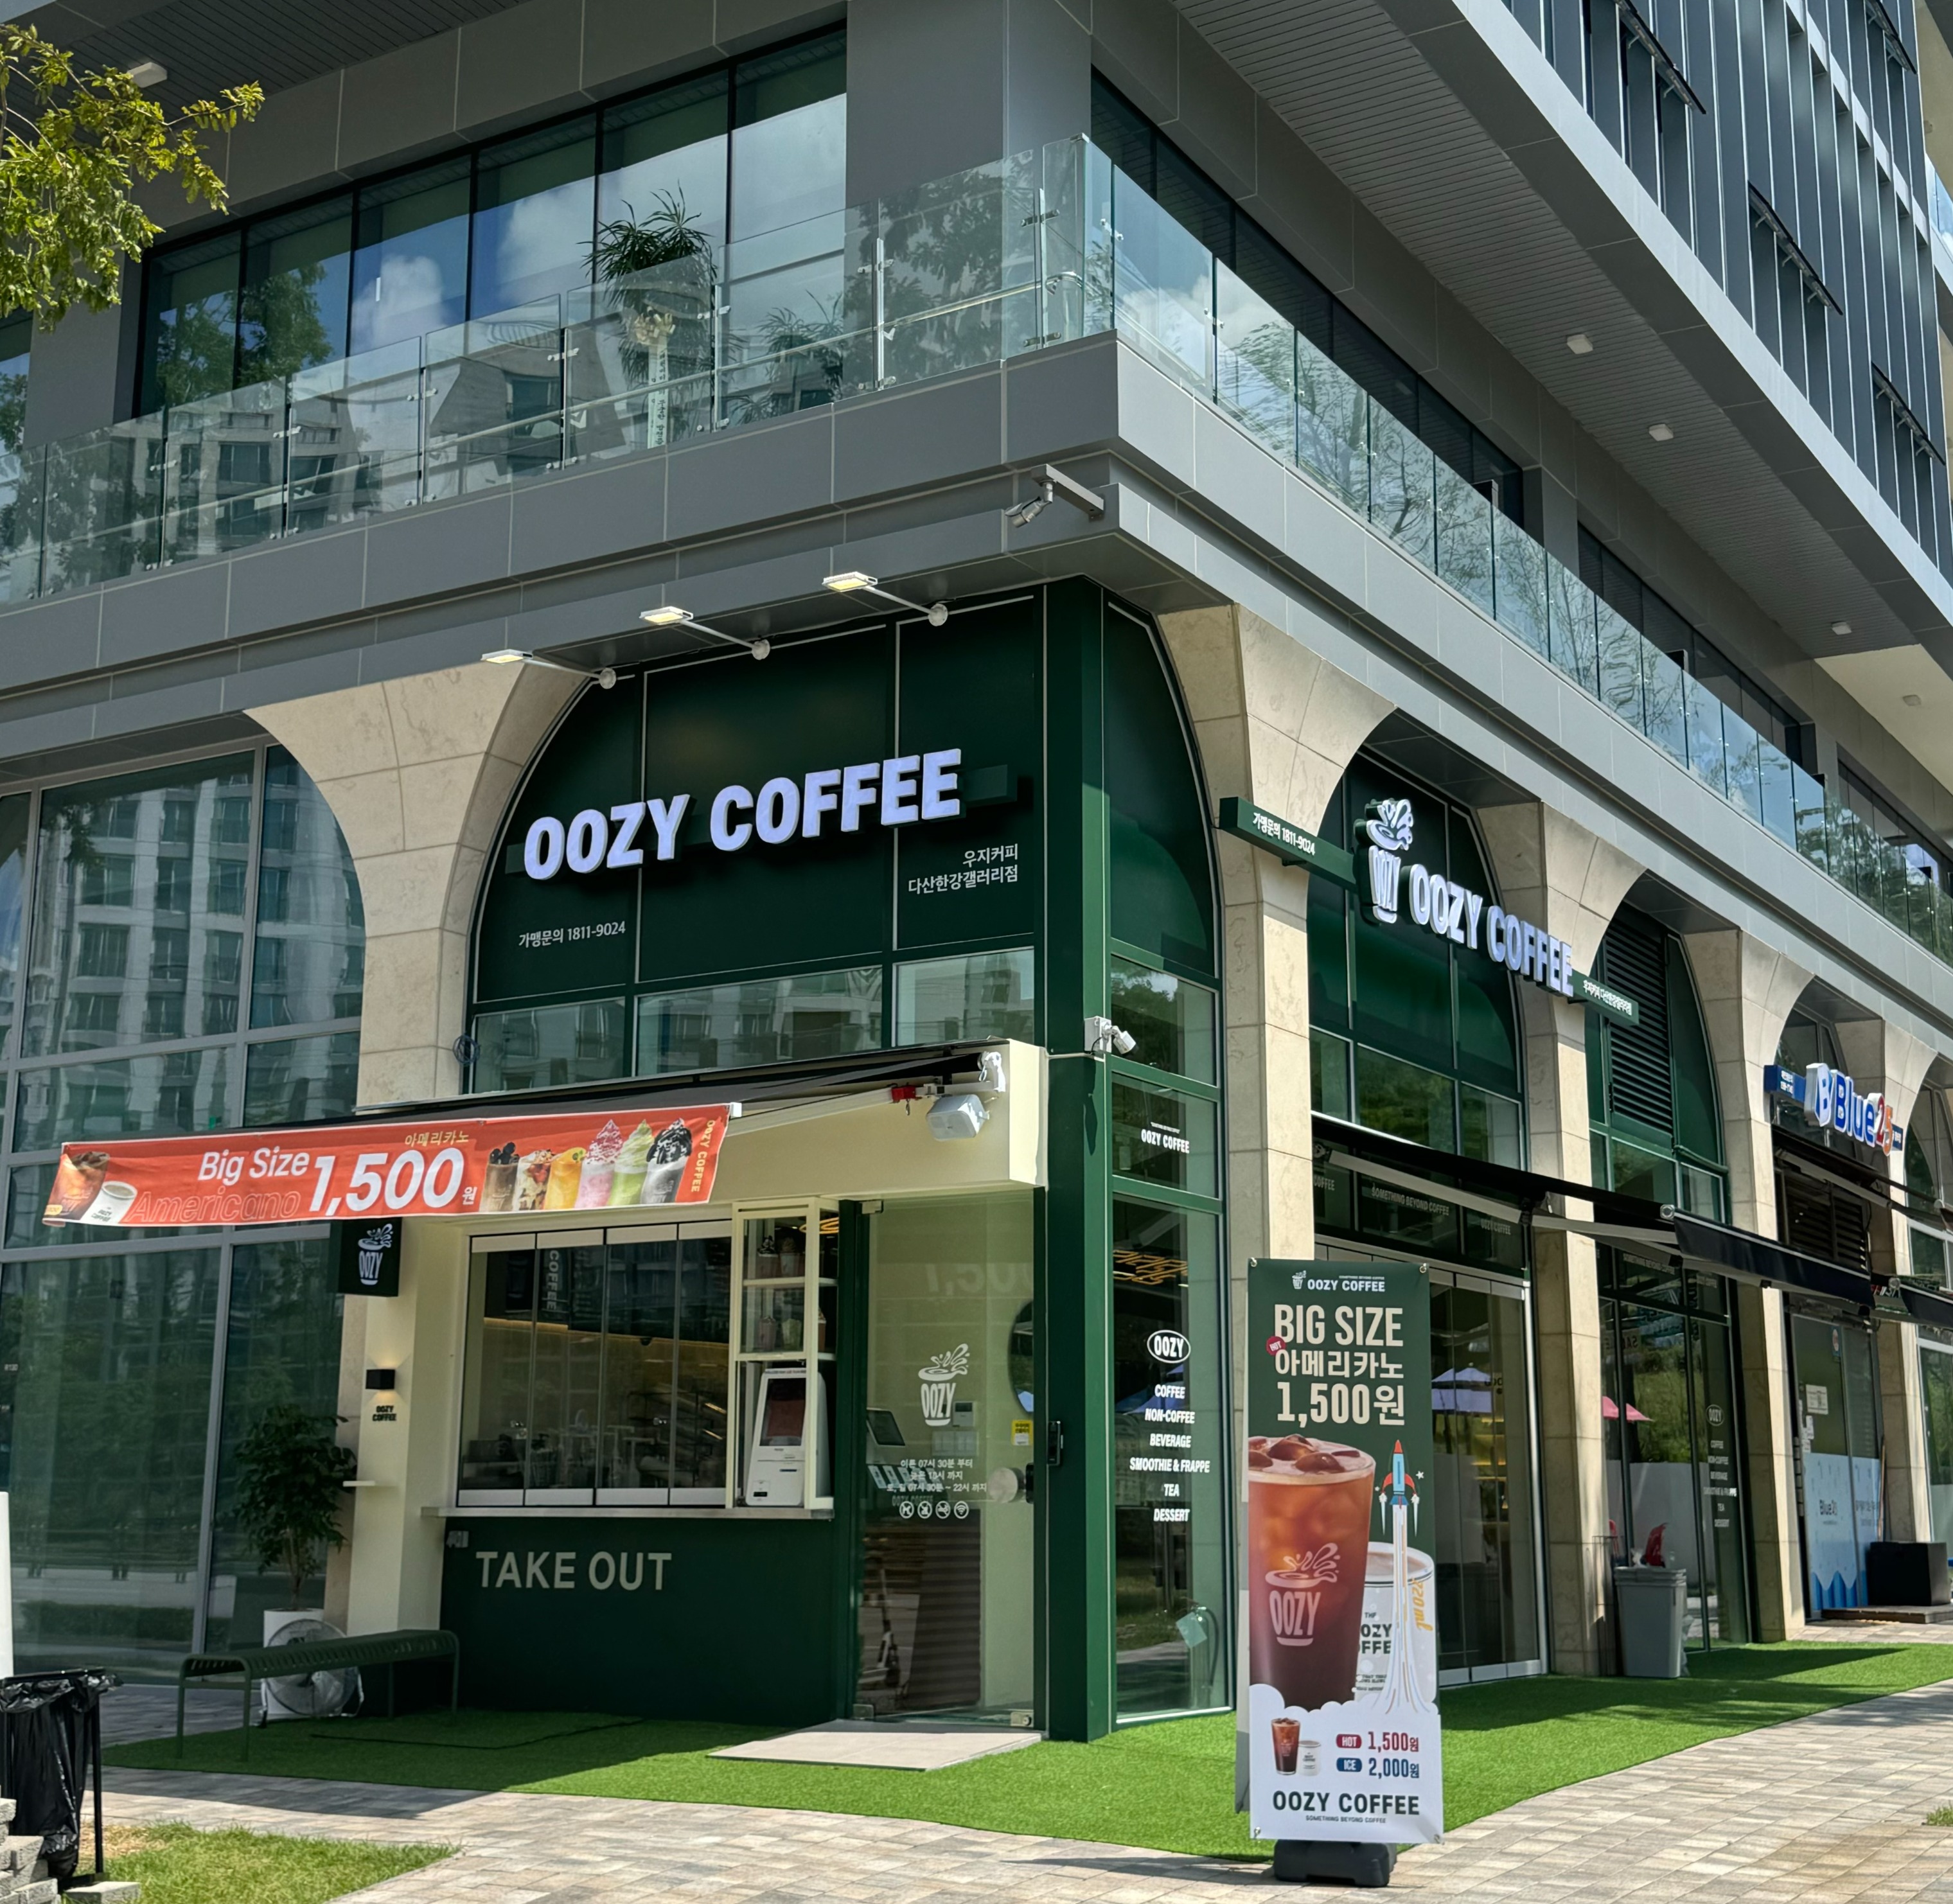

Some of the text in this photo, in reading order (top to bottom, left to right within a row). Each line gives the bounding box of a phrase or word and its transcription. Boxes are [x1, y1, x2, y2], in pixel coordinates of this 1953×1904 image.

[524, 748, 962, 881] OOZY COFFEE
[1253, 812, 1315, 856] 가맹문의 1811-9024
[962, 842, 1019, 868] 우지커피
[908, 865, 1019, 895] 다산한강갤러리점
[518, 921, 626, 949] 가맹문의 1811-9024
[1409, 863, 1574, 998] OOZY COFFEE
[404, 1130, 470, 1147] 아메리카노
[1141, 1129, 1190, 1154] OOZY COFFEE
[198, 1145, 309, 1186] Big Size
[691, 1120, 716, 1192] OOZY COFFEE
[126, 1186, 301, 1224] Americano
[358, 1250, 384, 1279] OOZY
[546, 1249, 560, 1311] COFFEE
[1307, 1279, 1338, 1291] OOZY
[1341, 1280, 1385, 1292] COFFEE
[1275, 1304, 1403, 1347] BIG SIZE
[1154, 1335, 1184, 1358] OOZY
[1275, 1350, 1404, 1379] 아메리카노
[921, 1382, 957, 1418] OOZY
[1154, 1384, 1186, 1399] COFFEE
[1145, 1408, 1196, 1424] NON-COFFEE
[1277, 1382, 1405, 1428] 1,500원
[1149, 1433, 1192, 1448] BEVERAGE
[918, 1459, 935, 1468] 07시
[1129, 1457, 1210, 1473] SMOOTHIE & FRAPPE
[953, 1483, 969, 1492] 22시
[1164, 1484, 1180, 1497] TEA
[1154, 1508, 1190, 1522] DESSERT
[475, 1551, 673, 1591] TAKE OUT
[1269, 1590, 1321, 1637] OOZY
[1358, 1640, 1392, 1654] FFE
[1341, 1736, 1357, 1747] HOT
[1368, 1731, 1419, 1753] 1,500원
[1343, 1759, 1357, 1770] ICE
[1368, 1757, 1419, 1779] 2,000원
[1273, 1790, 1420, 1815] OOZY COFFEE
